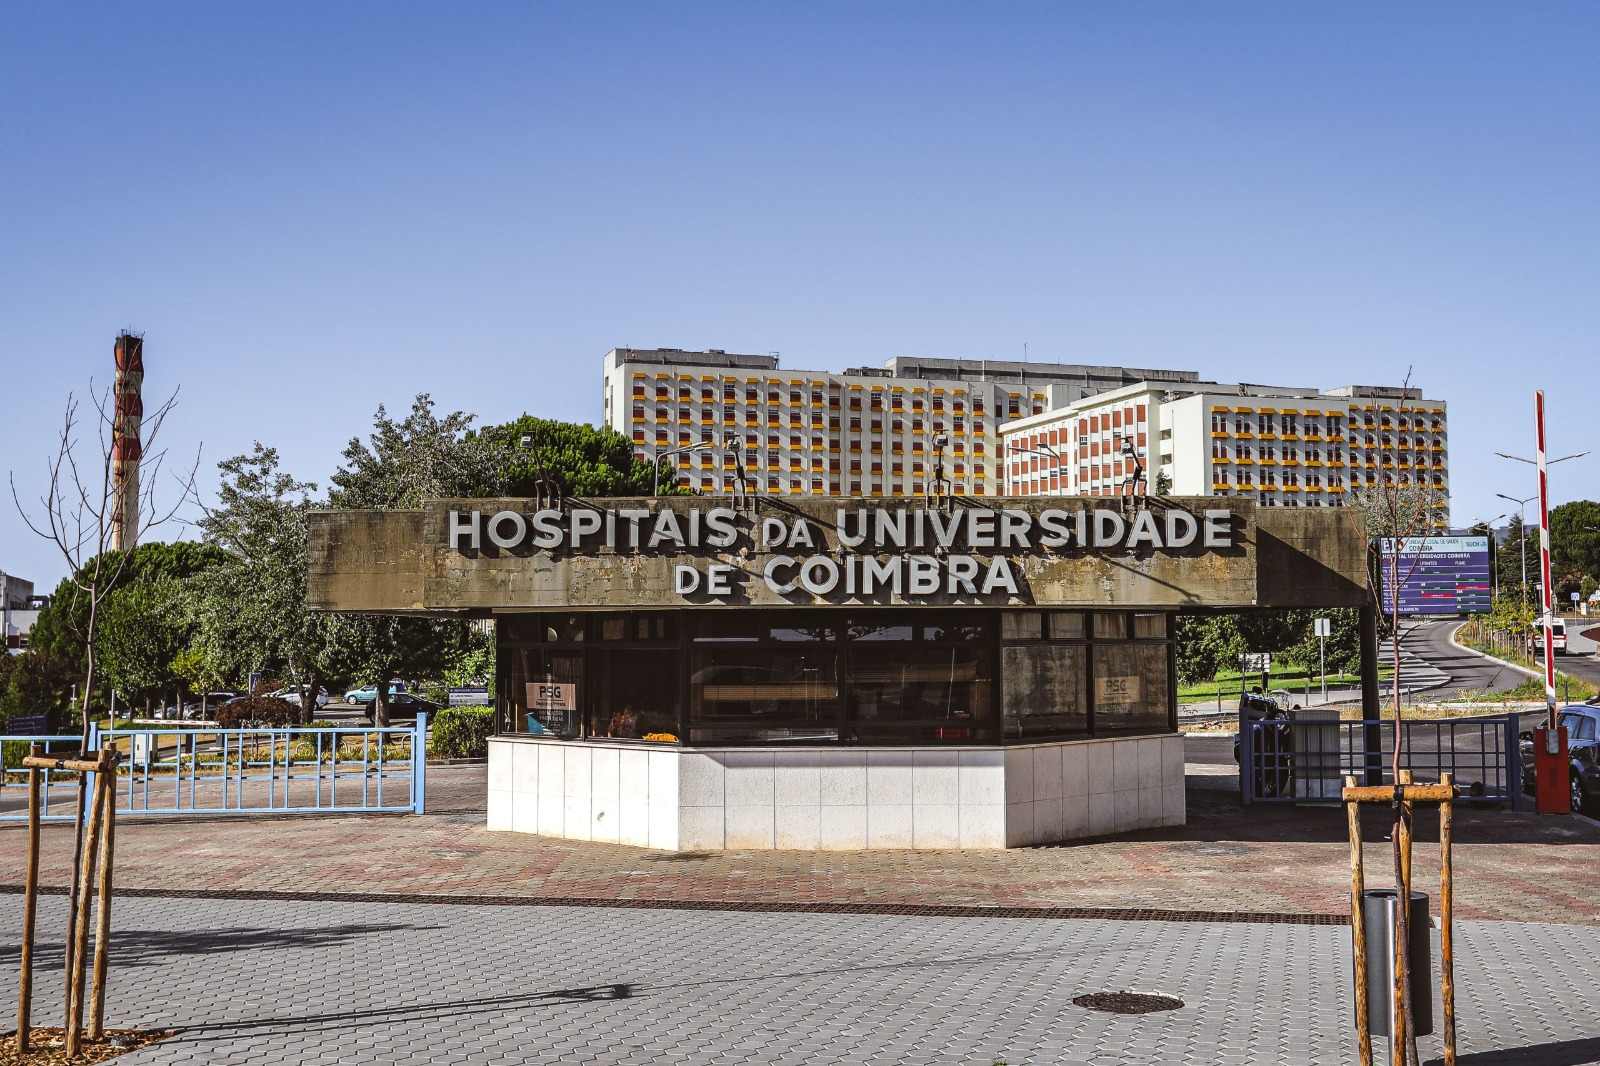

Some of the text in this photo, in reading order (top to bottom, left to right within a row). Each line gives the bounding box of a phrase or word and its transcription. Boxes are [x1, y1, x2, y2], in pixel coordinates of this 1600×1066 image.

[448, 507, 1232, 549] HOSPITAIS DA UNIVERSIDADE
[675, 555, 1019, 596] DE COIMBRA
[539, 685, 561, 699] PSG
[1105, 679, 1127, 692] PSG
